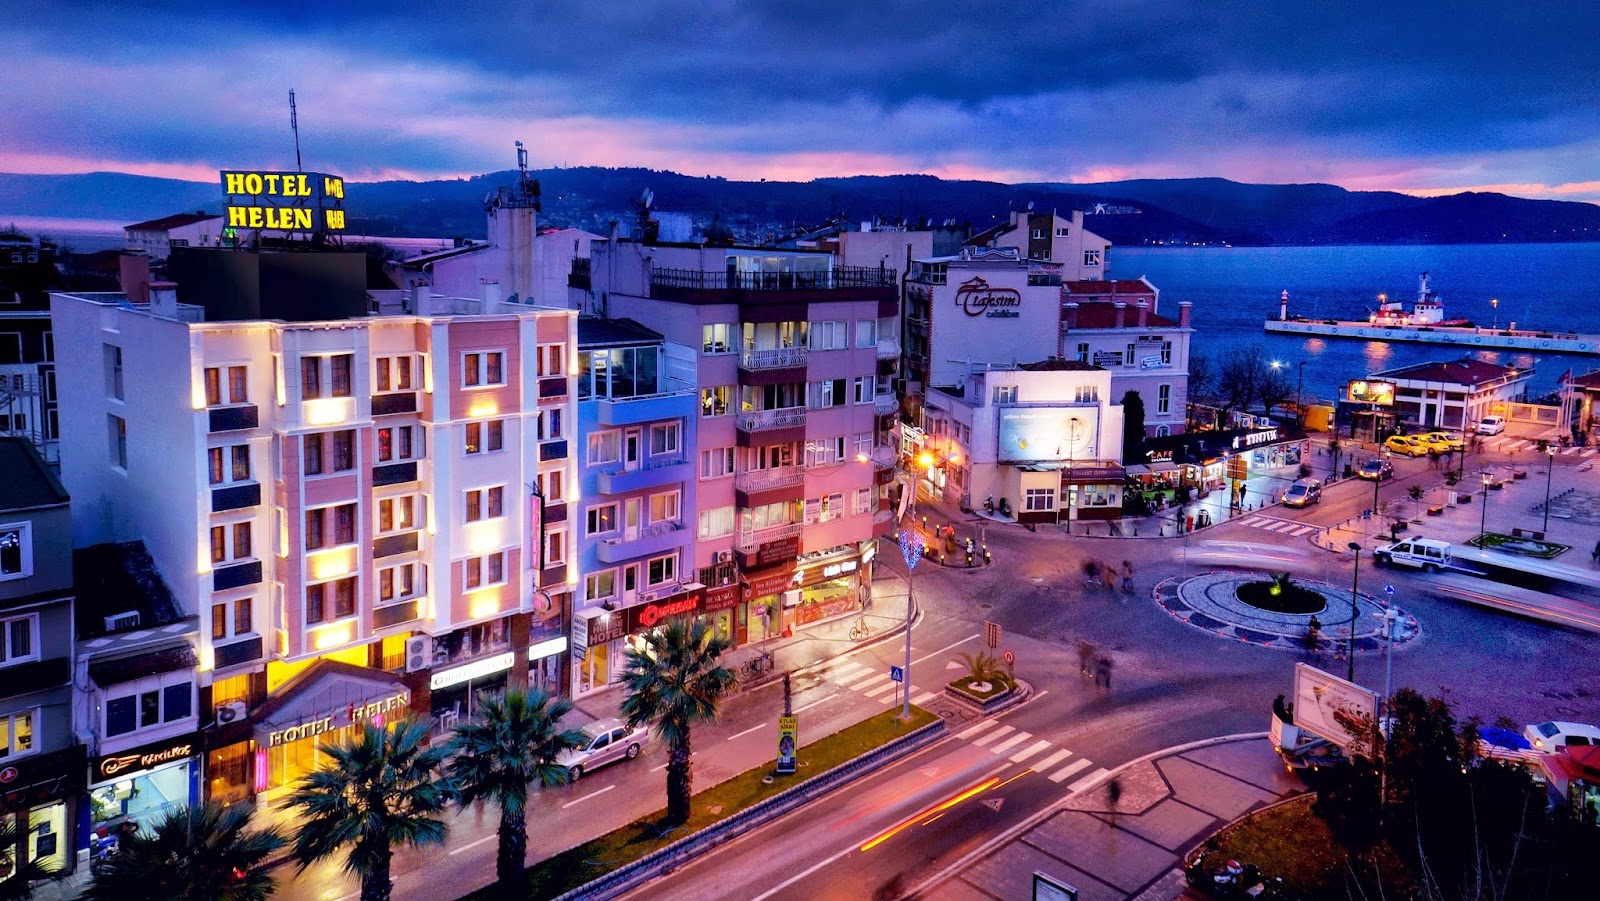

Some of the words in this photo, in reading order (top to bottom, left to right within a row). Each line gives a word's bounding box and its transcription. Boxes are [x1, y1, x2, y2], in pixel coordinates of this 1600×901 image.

[226, 173, 312, 196] HOTEL
[228, 206, 313, 229] HELEN
[1151, 450, 1173, 459] CAFE
[590, 627, 626, 646] HOTEL
[352, 691, 408, 723] HELEN
[268, 717, 336, 747] HOTEL
